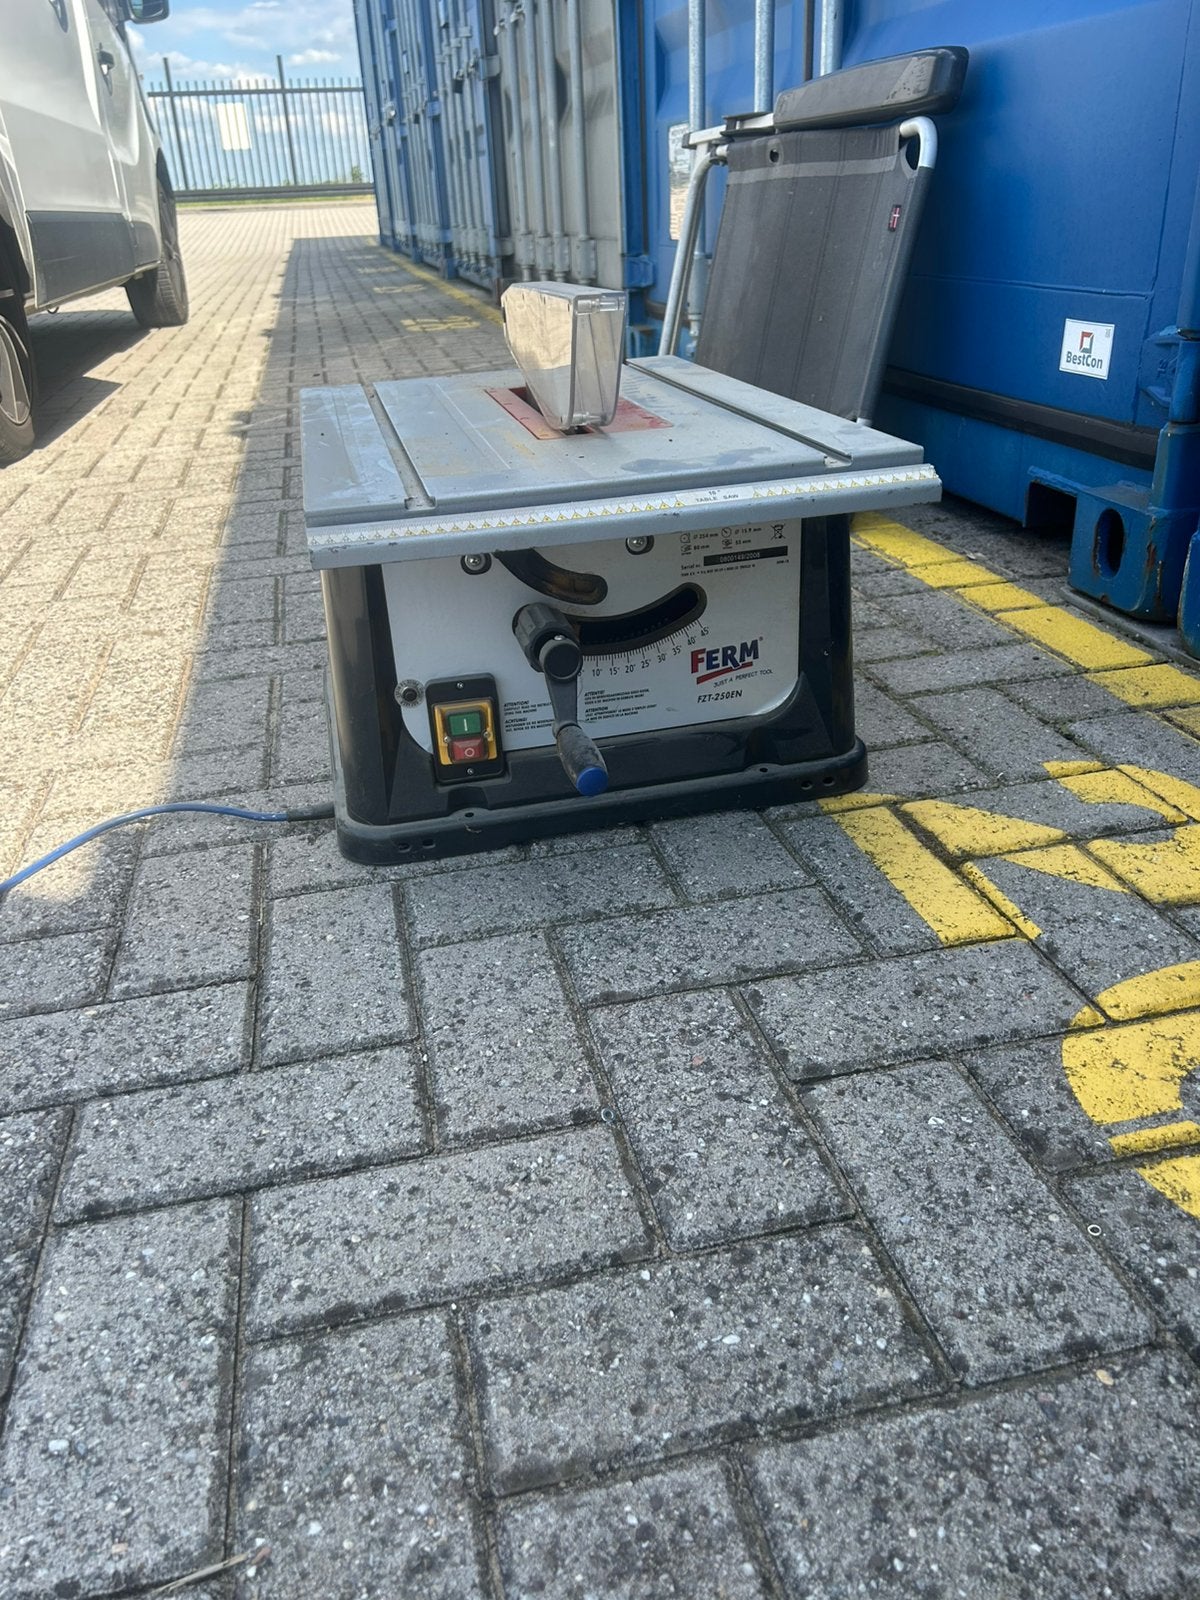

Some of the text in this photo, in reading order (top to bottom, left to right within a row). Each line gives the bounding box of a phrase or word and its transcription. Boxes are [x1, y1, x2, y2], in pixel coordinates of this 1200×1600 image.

[1066, 350, 1103, 369] BestCon
[690, 638, 759, 674] FERM
[713, 678, 728, 688] JUST
[734, 670, 758, 680] PERFECT
[759, 668, 773, 676] TOOL
[696, 689, 743, 703] FZT-250EN
